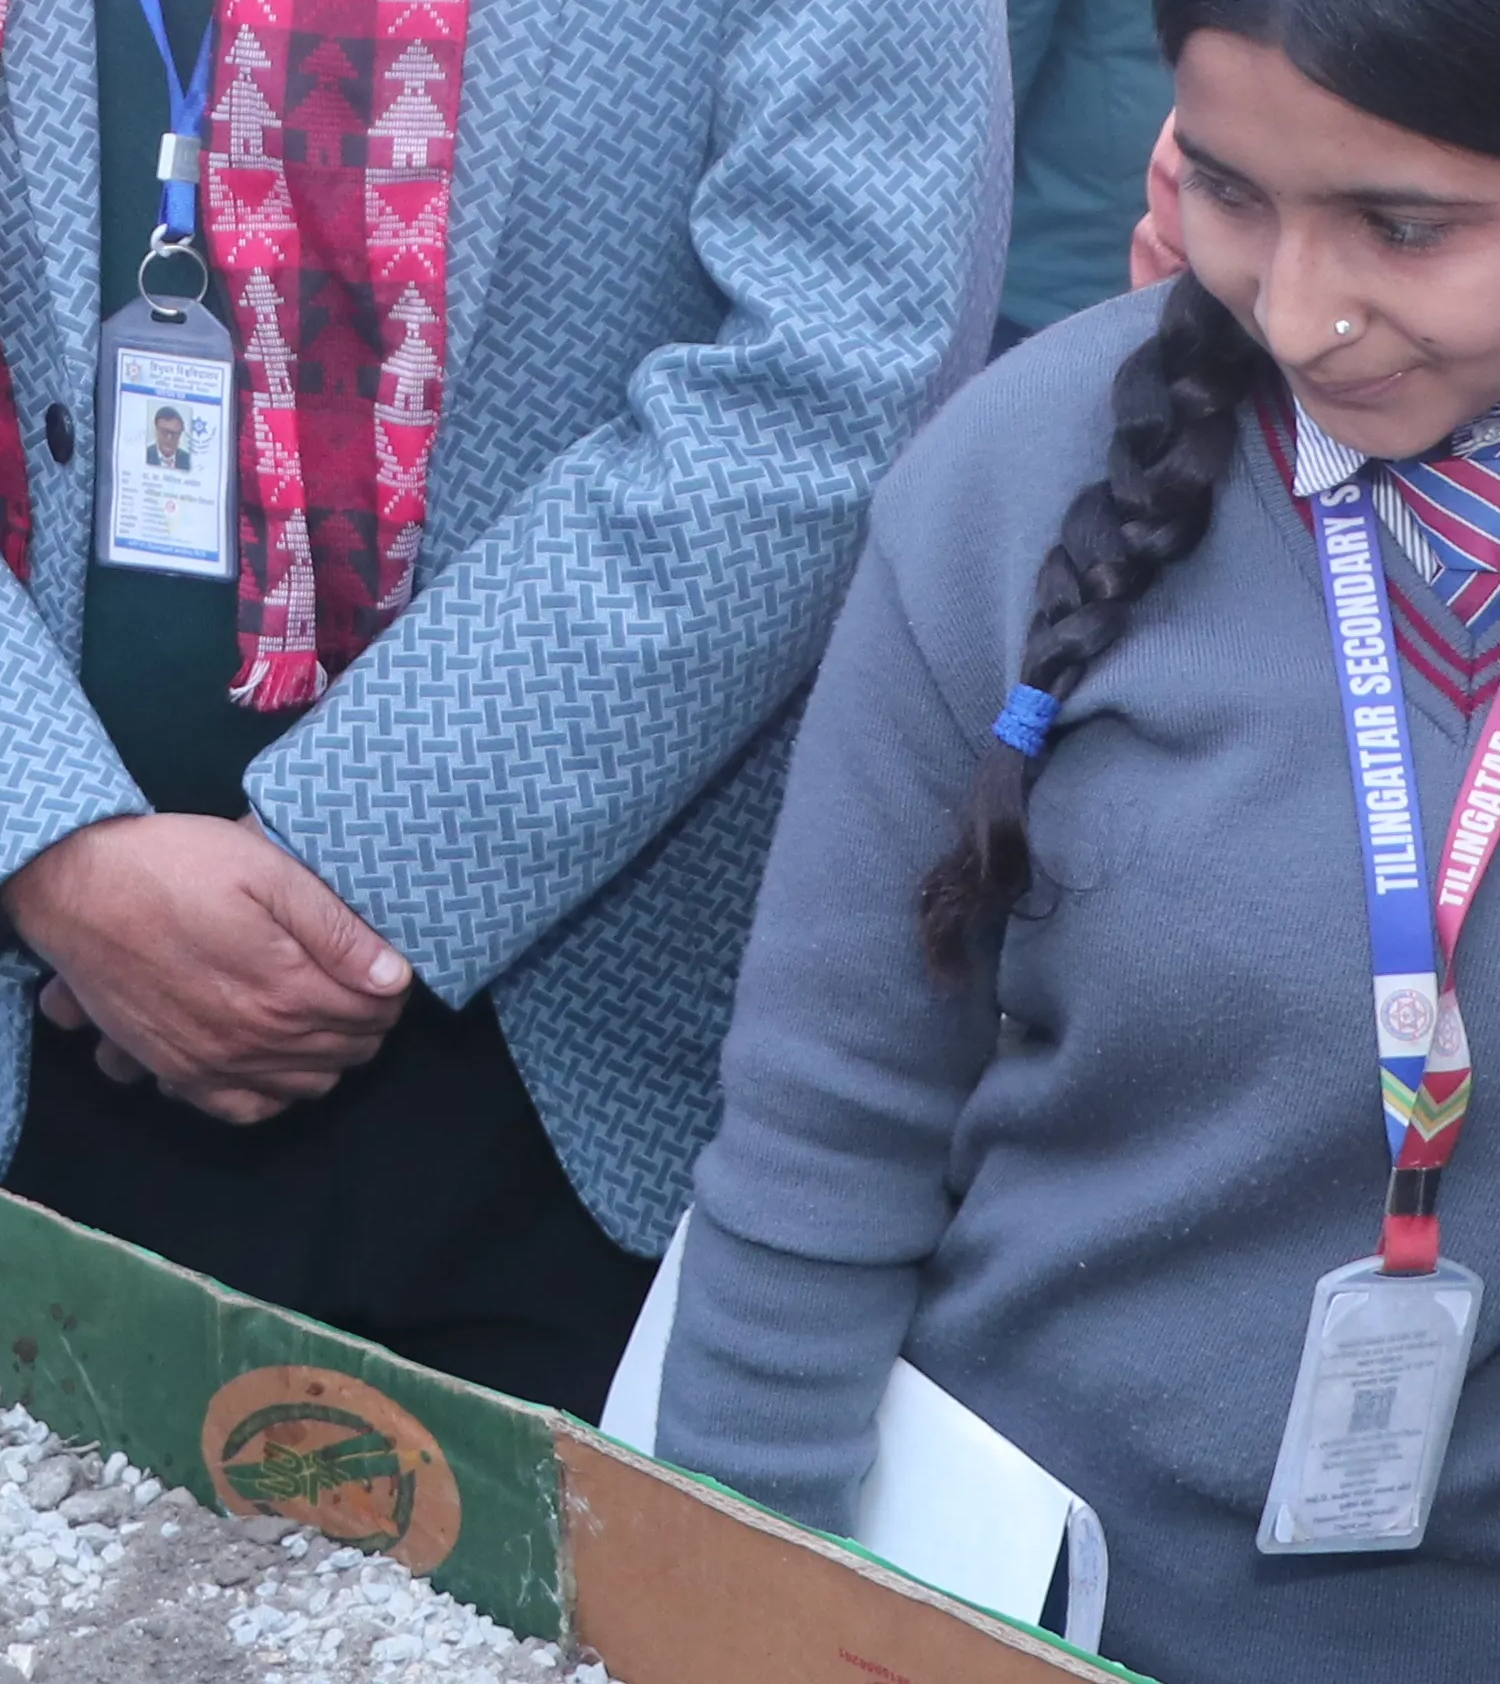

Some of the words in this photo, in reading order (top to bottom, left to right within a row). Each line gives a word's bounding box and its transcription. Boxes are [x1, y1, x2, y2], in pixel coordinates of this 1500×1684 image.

[1319, 482, 1361, 509] S
[1329, 516, 1392, 698] SECONDARY
[1351, 705, 1420, 895] TILINGATAR
